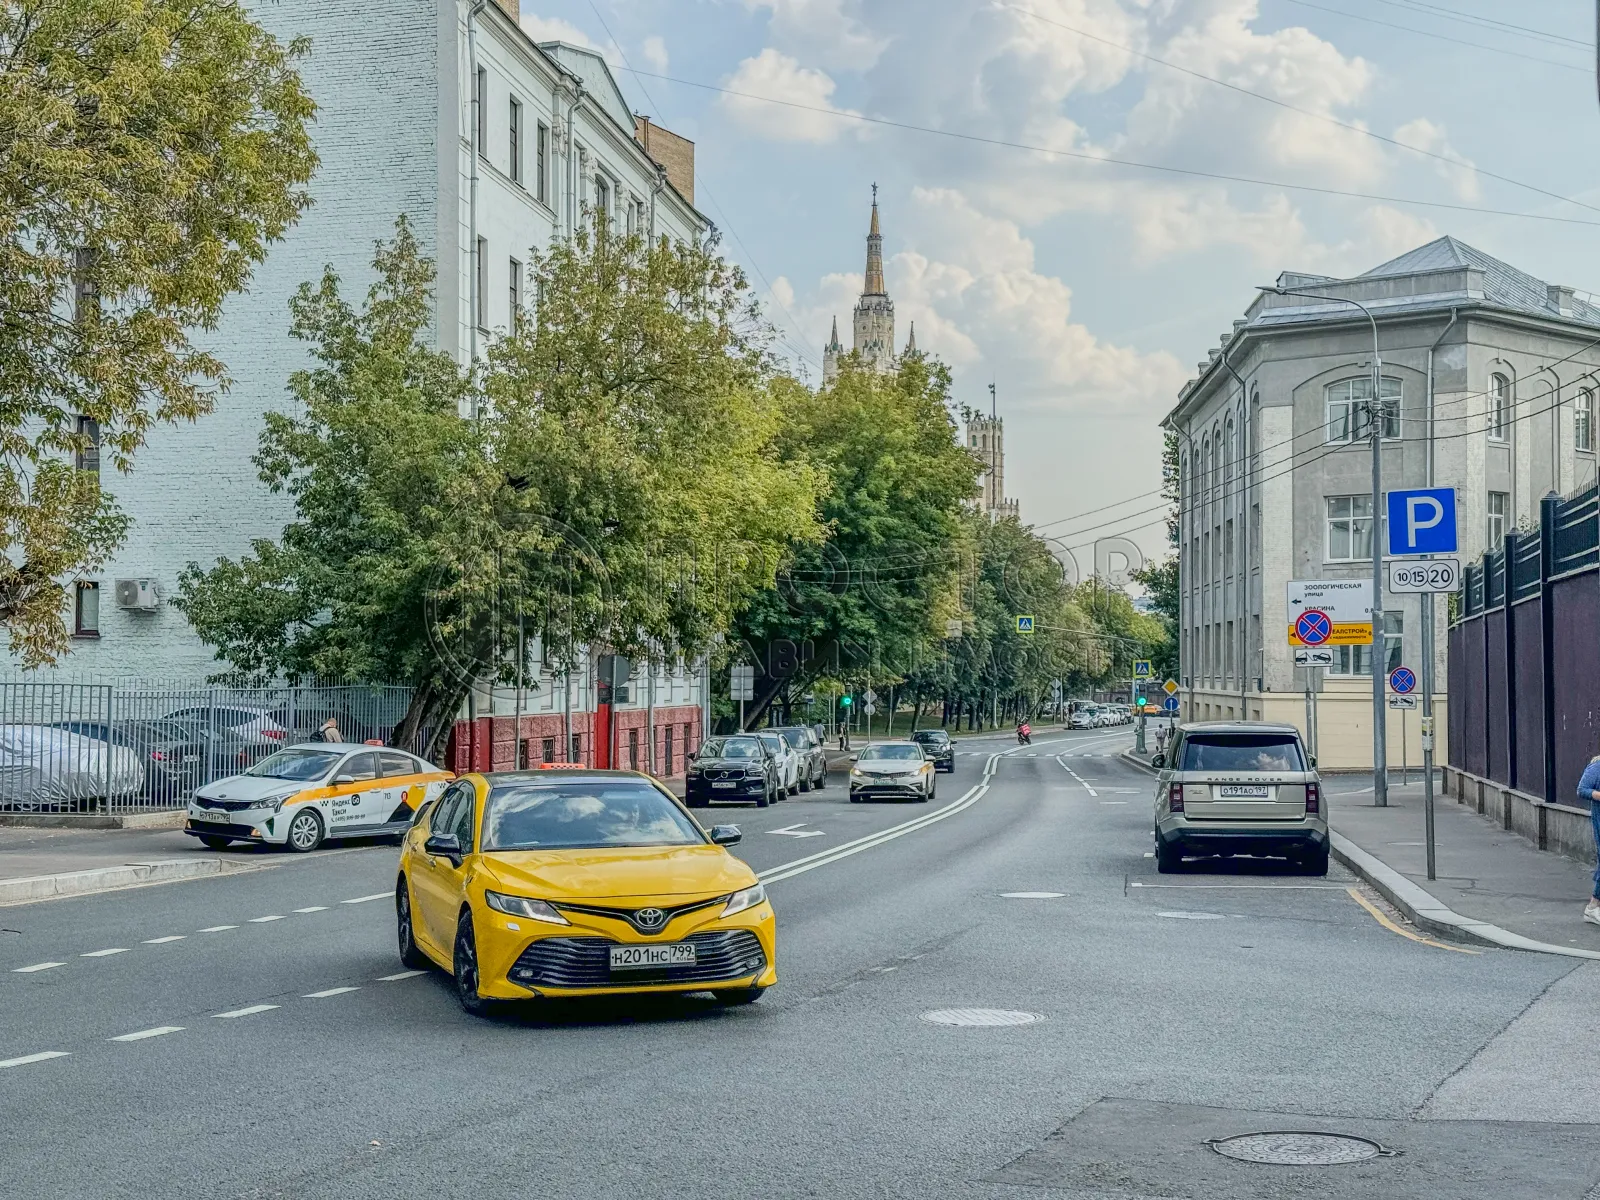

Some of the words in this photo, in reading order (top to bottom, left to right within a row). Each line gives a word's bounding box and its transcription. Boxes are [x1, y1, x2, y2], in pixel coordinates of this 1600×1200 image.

[1406, 496, 1444, 547] P
[1397, 573, 1408, 581] 10
[1412, 571, 1425, 582] 15
[1430, 569, 1450, 583] 20
[1223, 786, 1253, 794] О191АО
[1254, 786, 1266, 794] 197
[614, 948, 668, 964] Н201НС
[671, 946, 692, 957] 799
